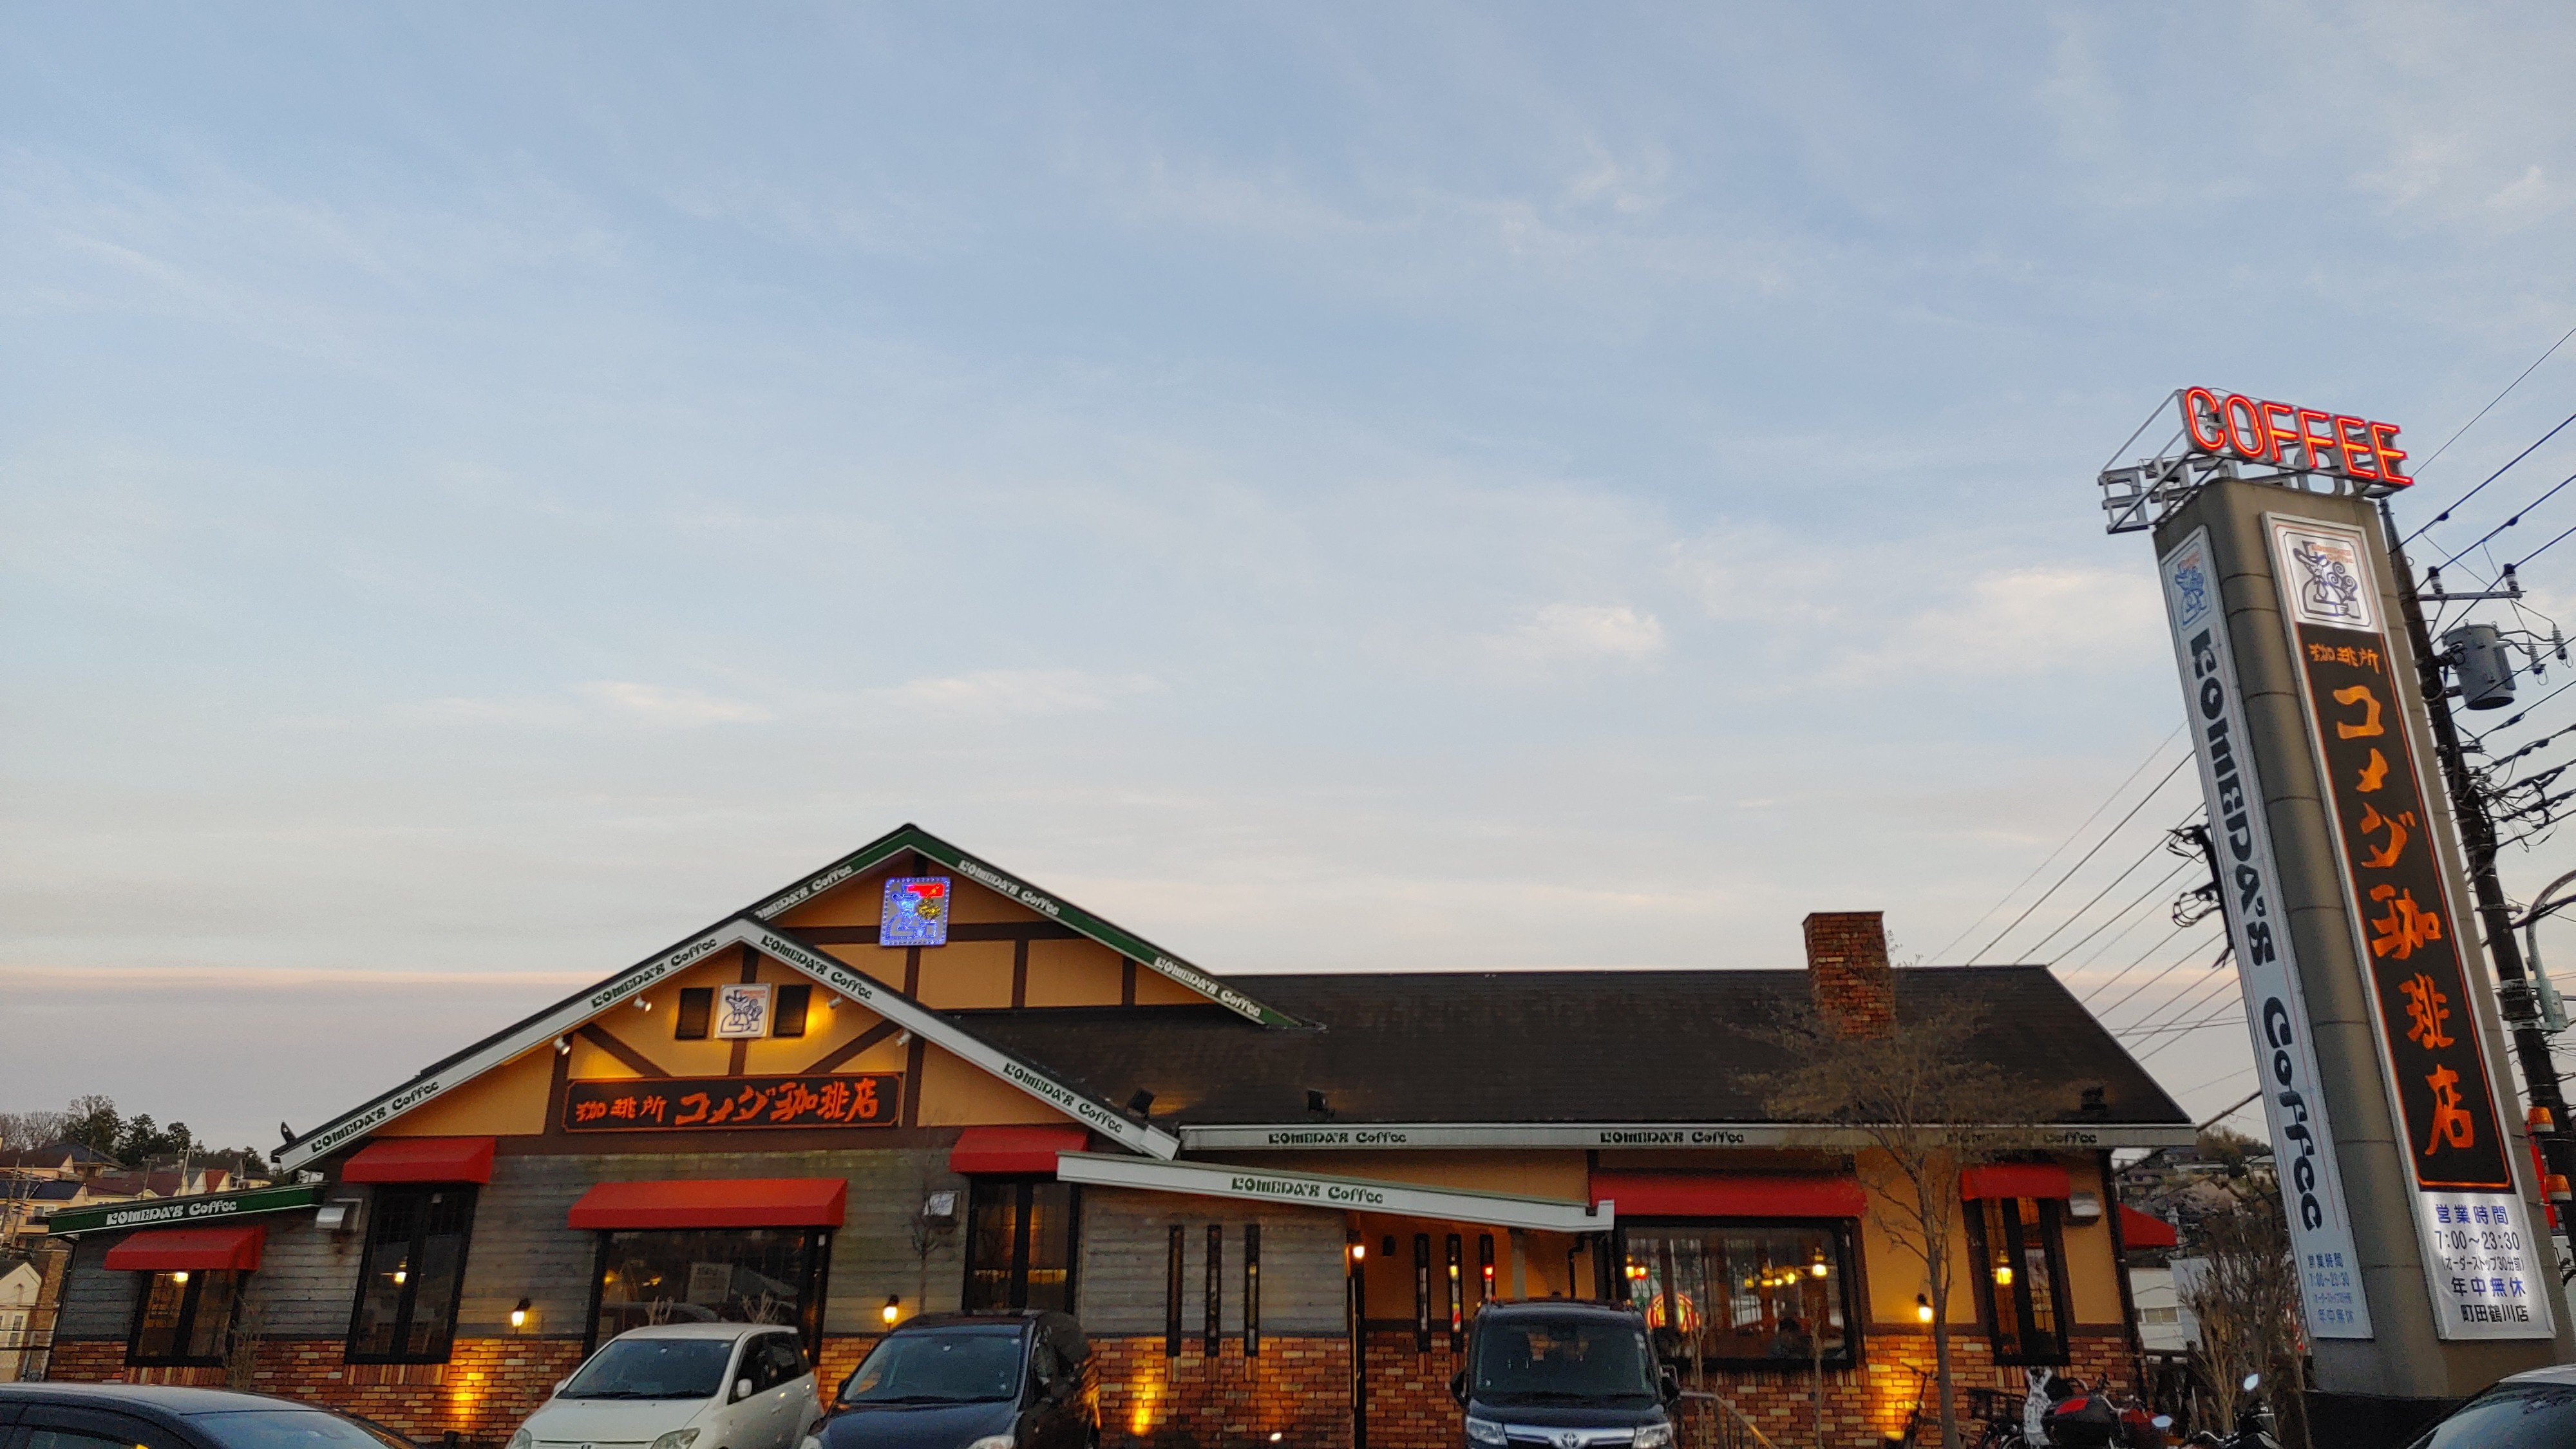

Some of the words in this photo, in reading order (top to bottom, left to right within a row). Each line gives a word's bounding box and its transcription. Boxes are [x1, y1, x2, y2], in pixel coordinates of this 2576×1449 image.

[2186, 386, 2414, 486] COFFEE
[2309, 643, 2380, 674] 珈琲所
[2333, 684, 2474, 1155] コメダ珈琲店
[670, 939, 717, 967] Coffee
[831, 971, 872, 999] Coffee
[392, 1082, 439, 1110] Coffee
[576, 1095, 668, 1122] 珈琲所
[674, 1078, 880, 1126] コメダ珈琲店
[1078, 1103, 1123, 1133] Coffee
[2264, 996, 2323, 1231] Coffee
[1356, 1132, 1406, 1143] Coffee
[189, 1200, 237, 1216] Coffee
[1328, 1186, 1383, 1204] Coffee
[2436, 1204, 2508, 1225] 営業時間
[2451, 1276, 2526, 1297] 年中無休
[2461, 1304, 2529, 1322] 町田鶴川店
